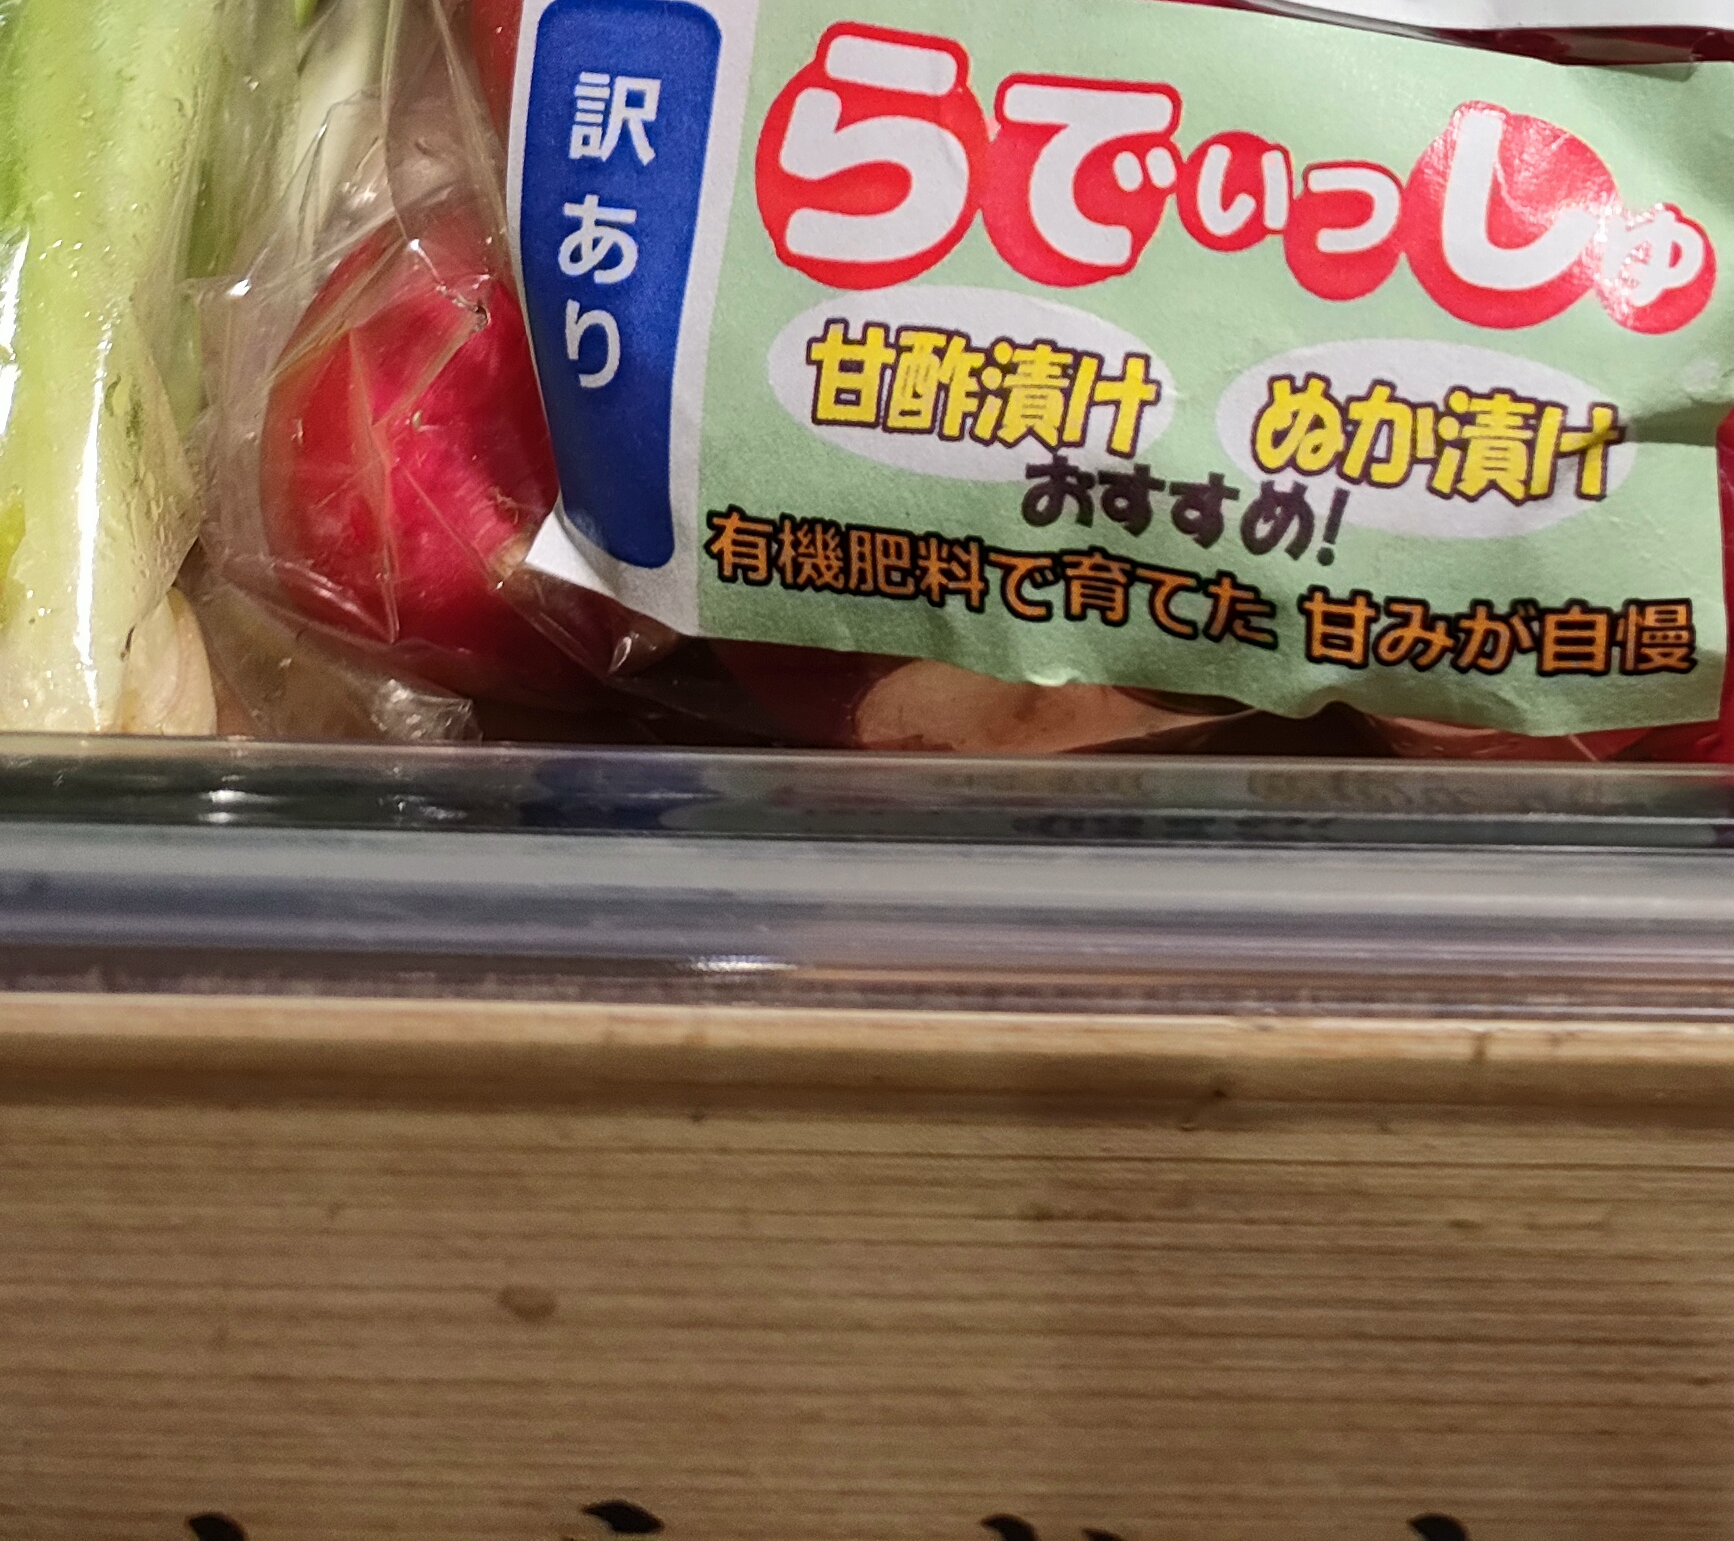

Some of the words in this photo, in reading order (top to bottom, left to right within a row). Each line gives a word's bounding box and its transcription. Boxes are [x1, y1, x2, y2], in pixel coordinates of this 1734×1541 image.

[557, 71, 662, 388] 訳あり
[806, 319, 1163, 459] 甘酢漬け
[1250, 371, 1626, 507] ぬか漬け
[706, 504, 1280, 649] 有機肥料で育てた
[1299, 583, 1697, 677] 甘みが自慢
[1021, 452, 1351, 567] おすすめ!
